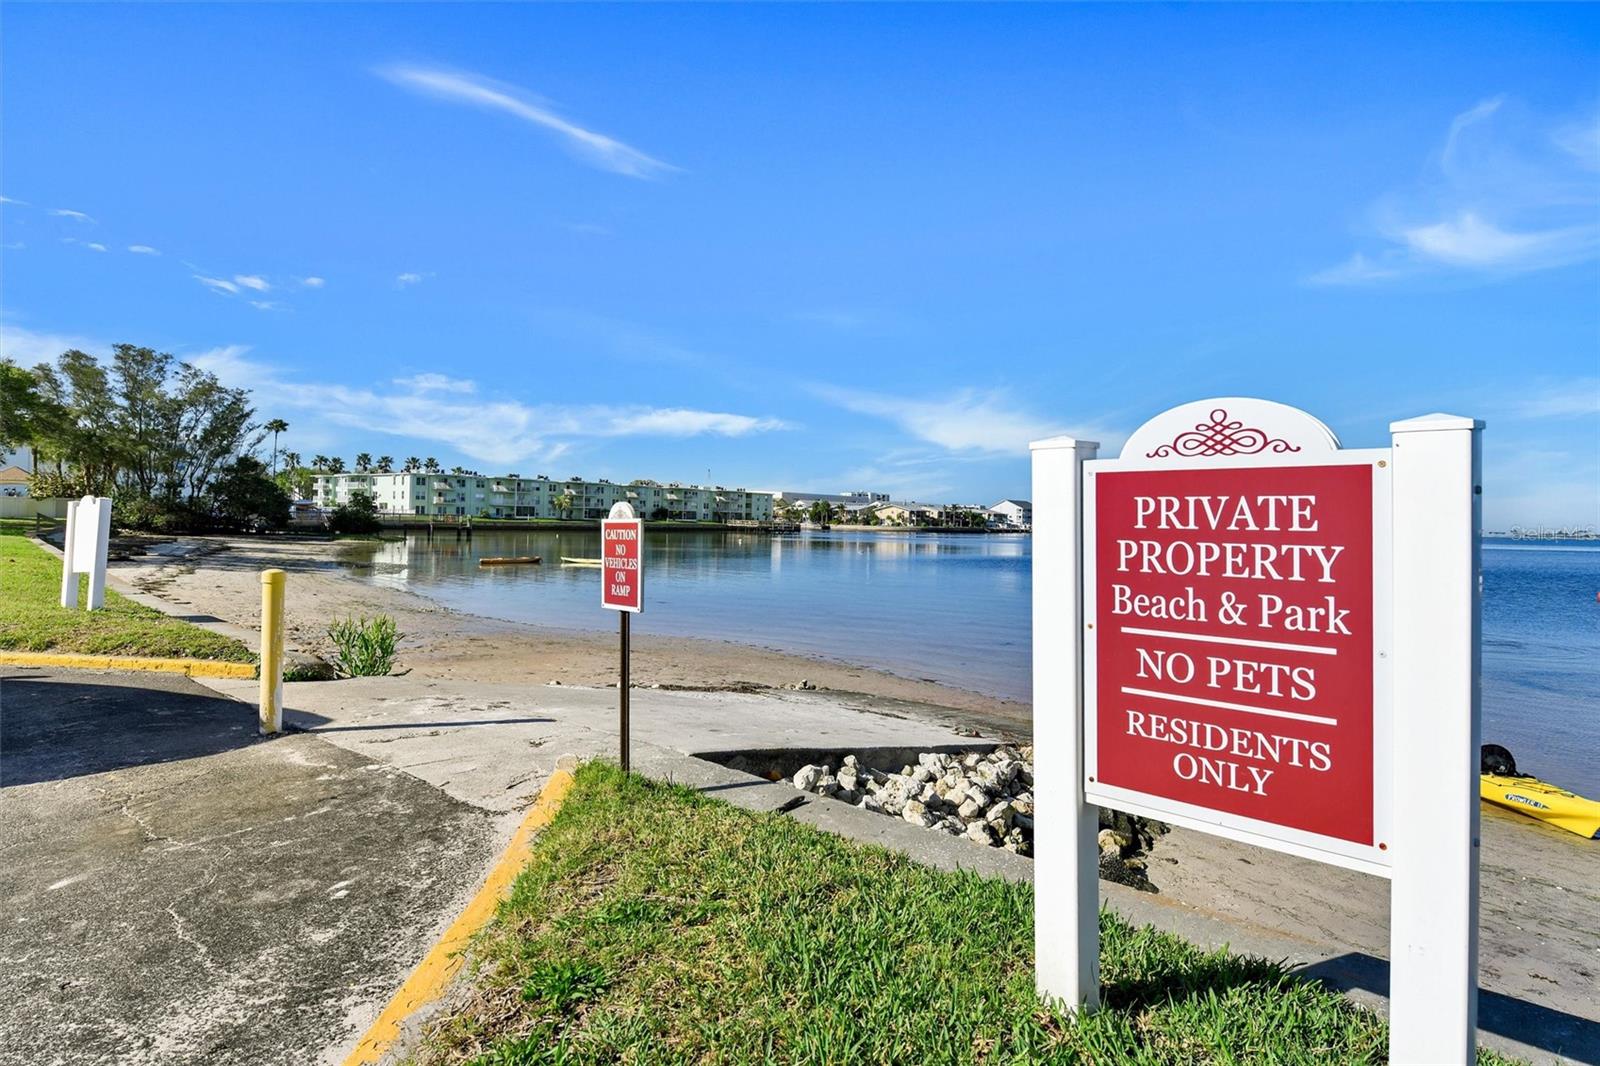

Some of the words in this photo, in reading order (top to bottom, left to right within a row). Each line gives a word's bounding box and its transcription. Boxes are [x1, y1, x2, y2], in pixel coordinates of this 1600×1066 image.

[1134, 495, 1319, 532] PRIVATE
[605, 529, 636, 540] CAUTION
[615, 544, 626, 555] NO
[605, 557, 638, 569] VEHICLES
[615, 571, 626, 582] ON
[1116, 539, 1345, 583] PROPERTY
[611, 584, 631, 596] RAMP
[1111, 584, 1208, 622] Beach
[1218, 591, 1248, 626] &
[1258, 593, 1353, 636] Park
[1135, 647, 1195, 684] NO
[1206, 656, 1317, 701] PETS
[1126, 709, 1332, 772] RESIDENTS
[1173, 752, 1274, 797] ONLY
